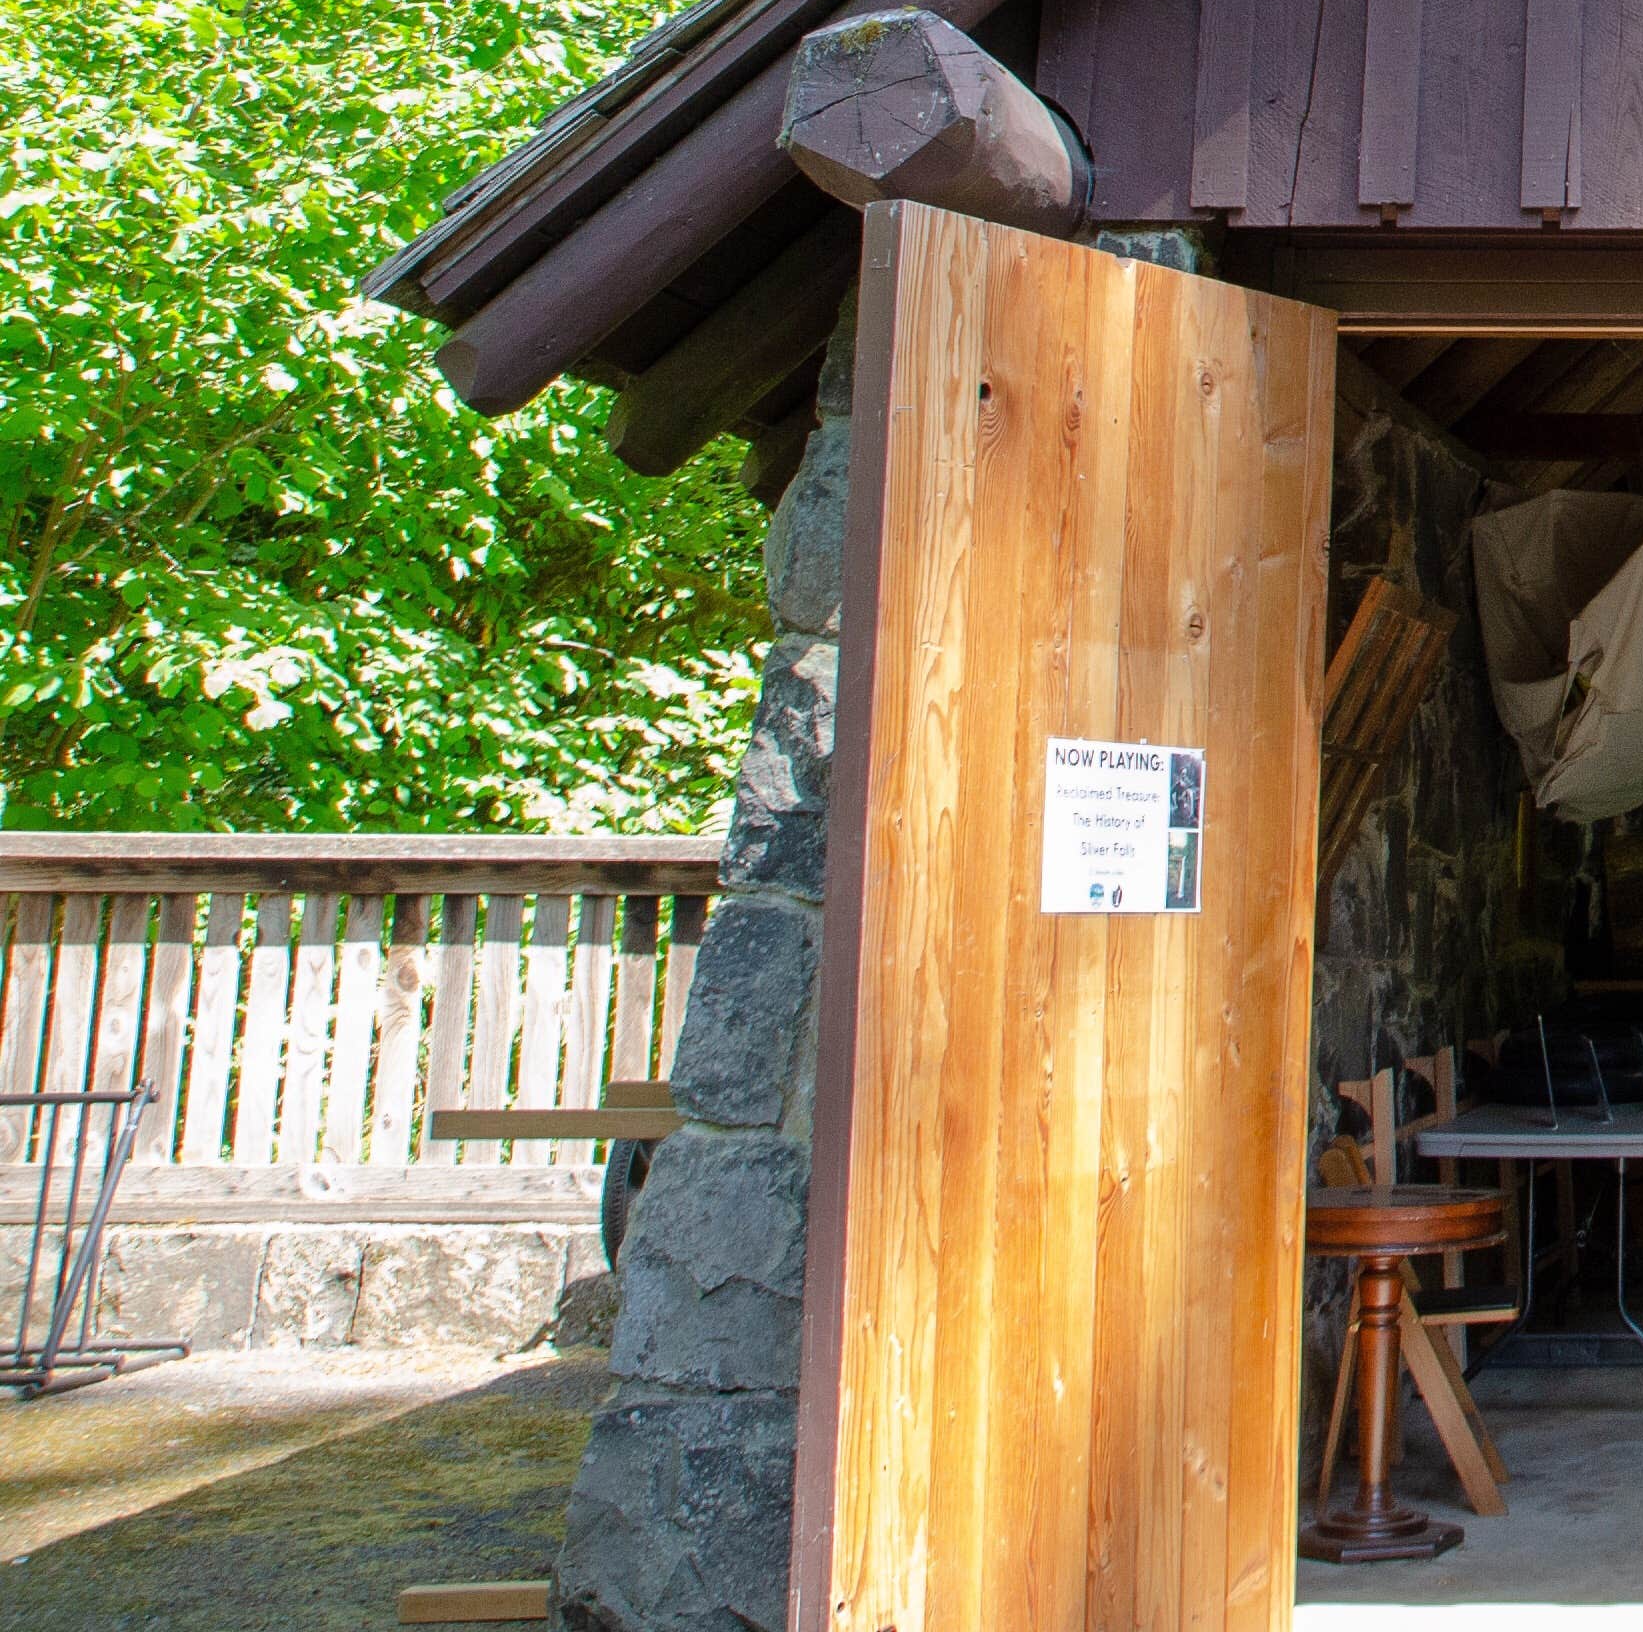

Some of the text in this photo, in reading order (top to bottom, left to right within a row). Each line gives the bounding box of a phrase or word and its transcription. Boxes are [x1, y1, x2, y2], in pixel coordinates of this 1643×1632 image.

[1055, 747, 1165, 771] NOW PLAYING:
[1056, 784, 1113, 800] Reclaimed
[1072, 812, 1146, 830] The History of
[1080, 841, 1136, 857] Silver Falls
